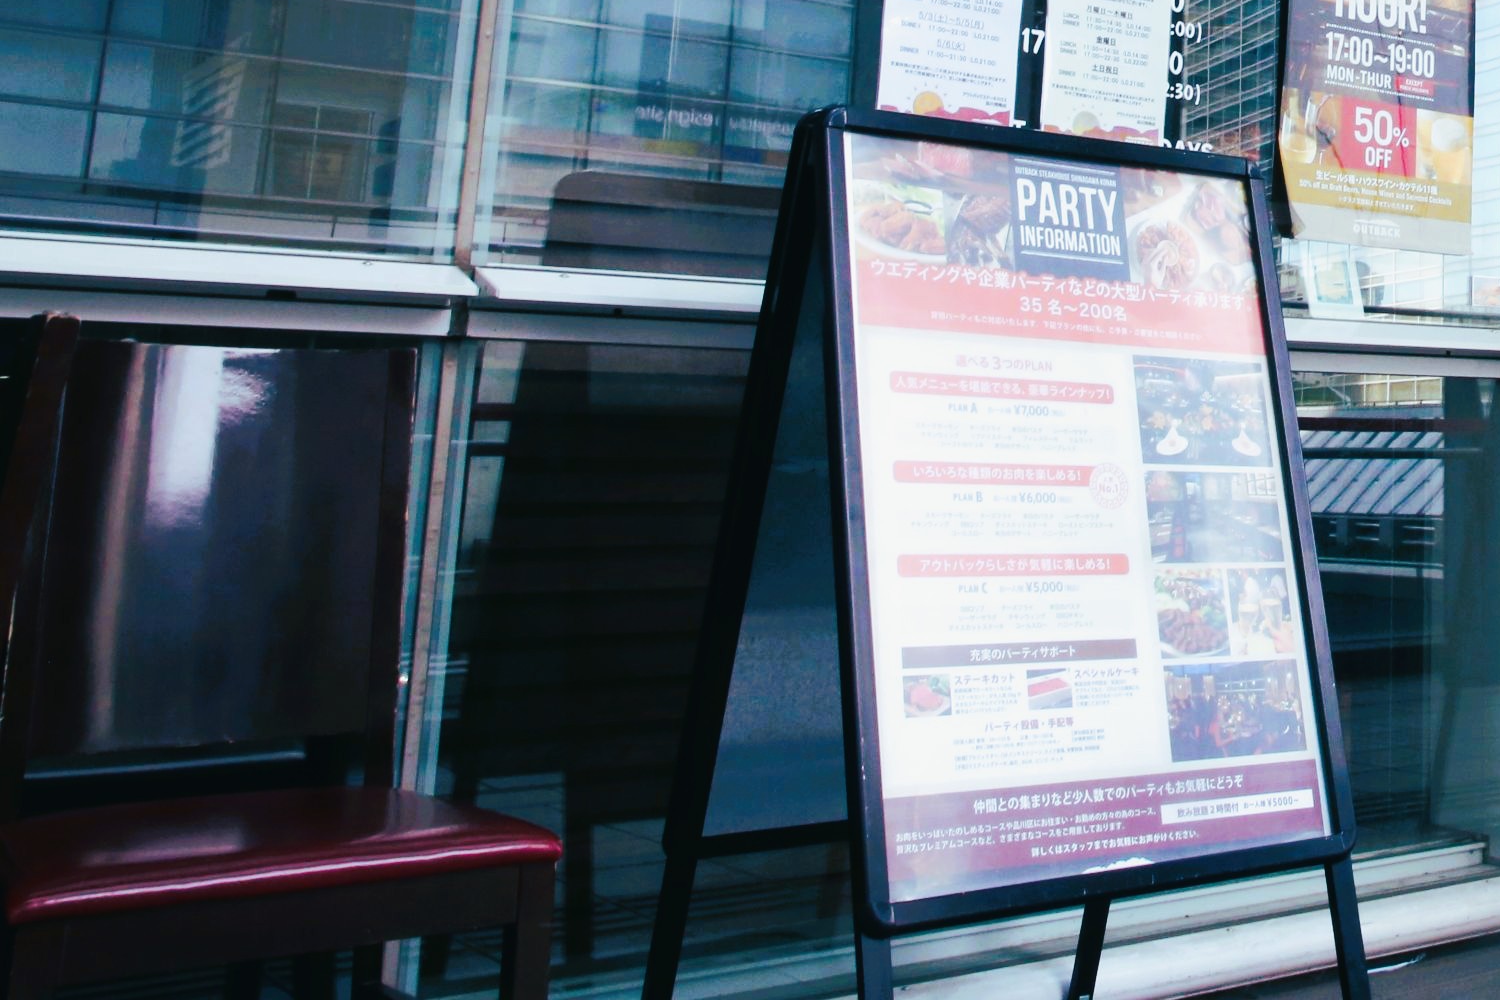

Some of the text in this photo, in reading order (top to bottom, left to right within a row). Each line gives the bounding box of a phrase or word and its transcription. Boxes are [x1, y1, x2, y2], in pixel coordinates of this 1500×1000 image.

[1169, 20, 1203, 43] :00)
[1022, 28, 1184, 75] 17 0
[1354, 106, 1410, 148] 50%
[1365, 147, 1392, 168] OFF
[1016, 178, 1117, 232] PARTY
[1353, 224, 1400, 239] OUTBACK
[1020, 225, 1121, 257] INFORMATION
[1020, 296, 1042, 312] 35
[948, 403, 968, 413] PLAN
[970, 402, 978, 414] A
[1099, 482, 1119, 494] No.1
[953, 493, 973, 502] PLAN
[976, 491, 983, 502] B
[1019, 492, 1056, 504] ¥6,000
[958, 584, 979, 593] PLAN
[981, 582, 988, 594] C
[1026, 581, 1063, 594] ¥5,000
[970, 646, 1076, 661] 充実のパーティサポート
[954, 673, 1015, 685] ステーキカット
[1074, 667, 1139, 679] スペシャルケーキ
